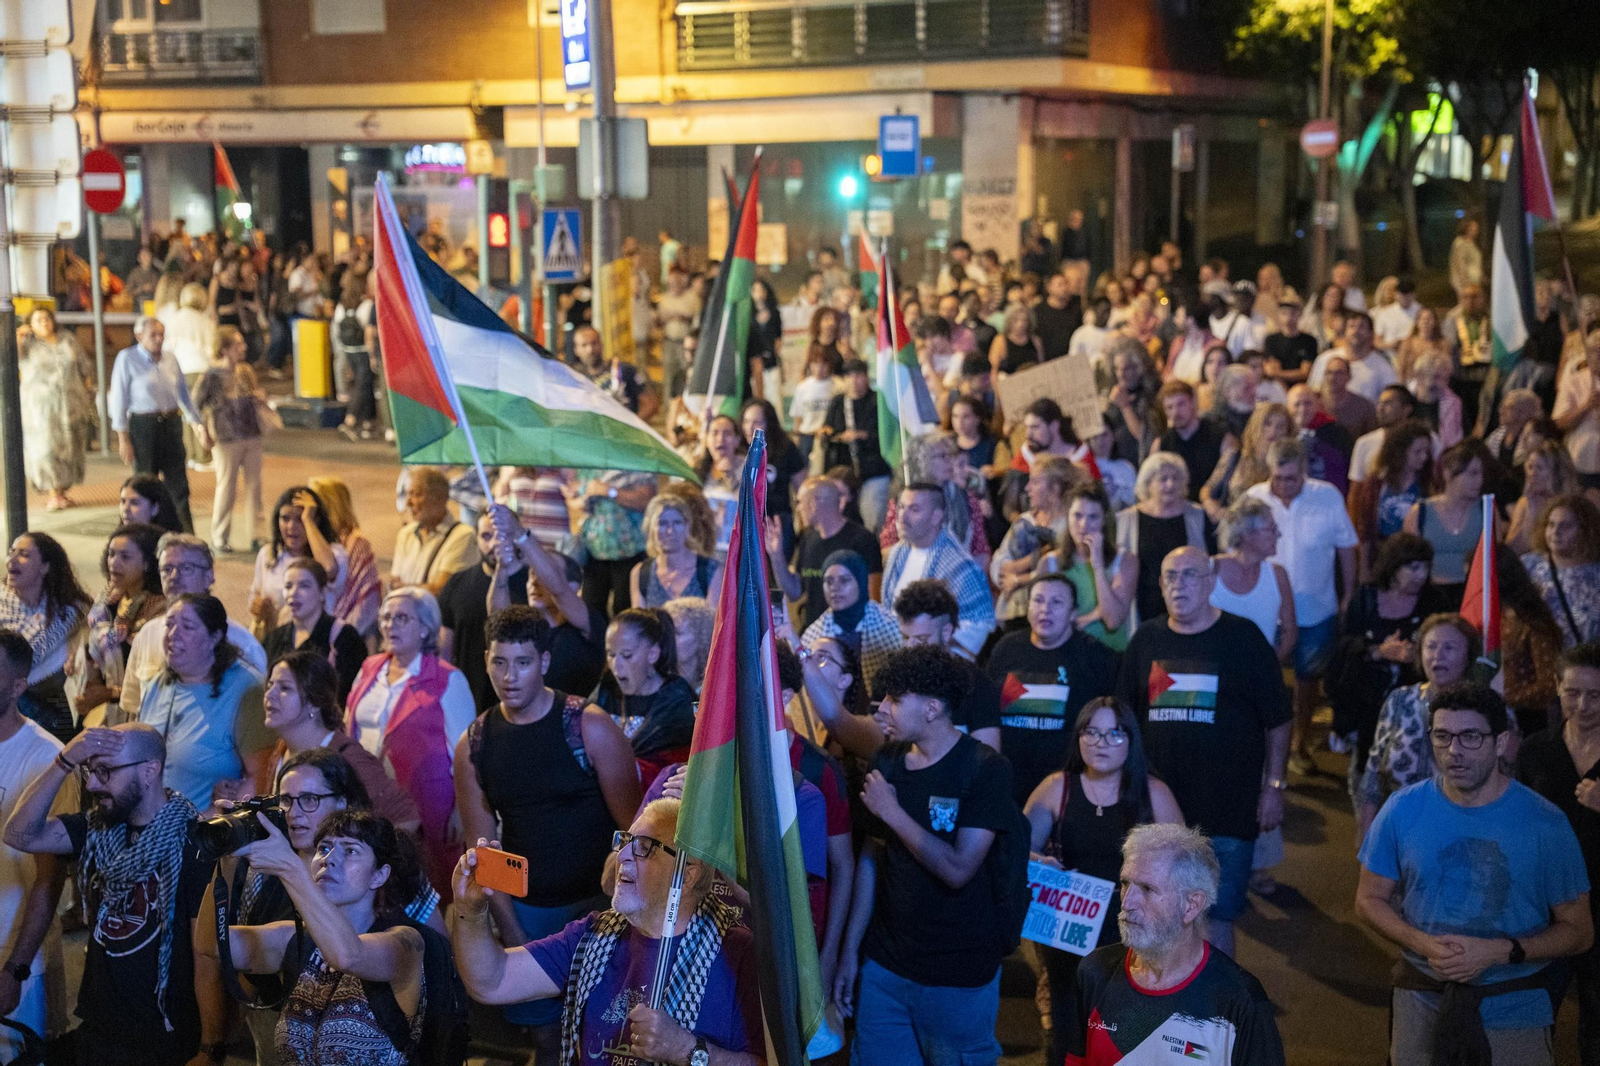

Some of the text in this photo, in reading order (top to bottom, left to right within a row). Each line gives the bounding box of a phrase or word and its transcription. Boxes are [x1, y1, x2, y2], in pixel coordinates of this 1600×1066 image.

[1149, 708, 1215, 724] PALESTINA LIBRE
[1039, 717, 1064, 731] LIBRE
[671, 903, 676, 912] cm
[218, 906, 226, 941] SONY
[1060, 920, 1093, 949] LIBRE
[1162, 1034, 1185, 1047] PALESTINA
[1170, 1045, 1184, 1055] LIBRE
